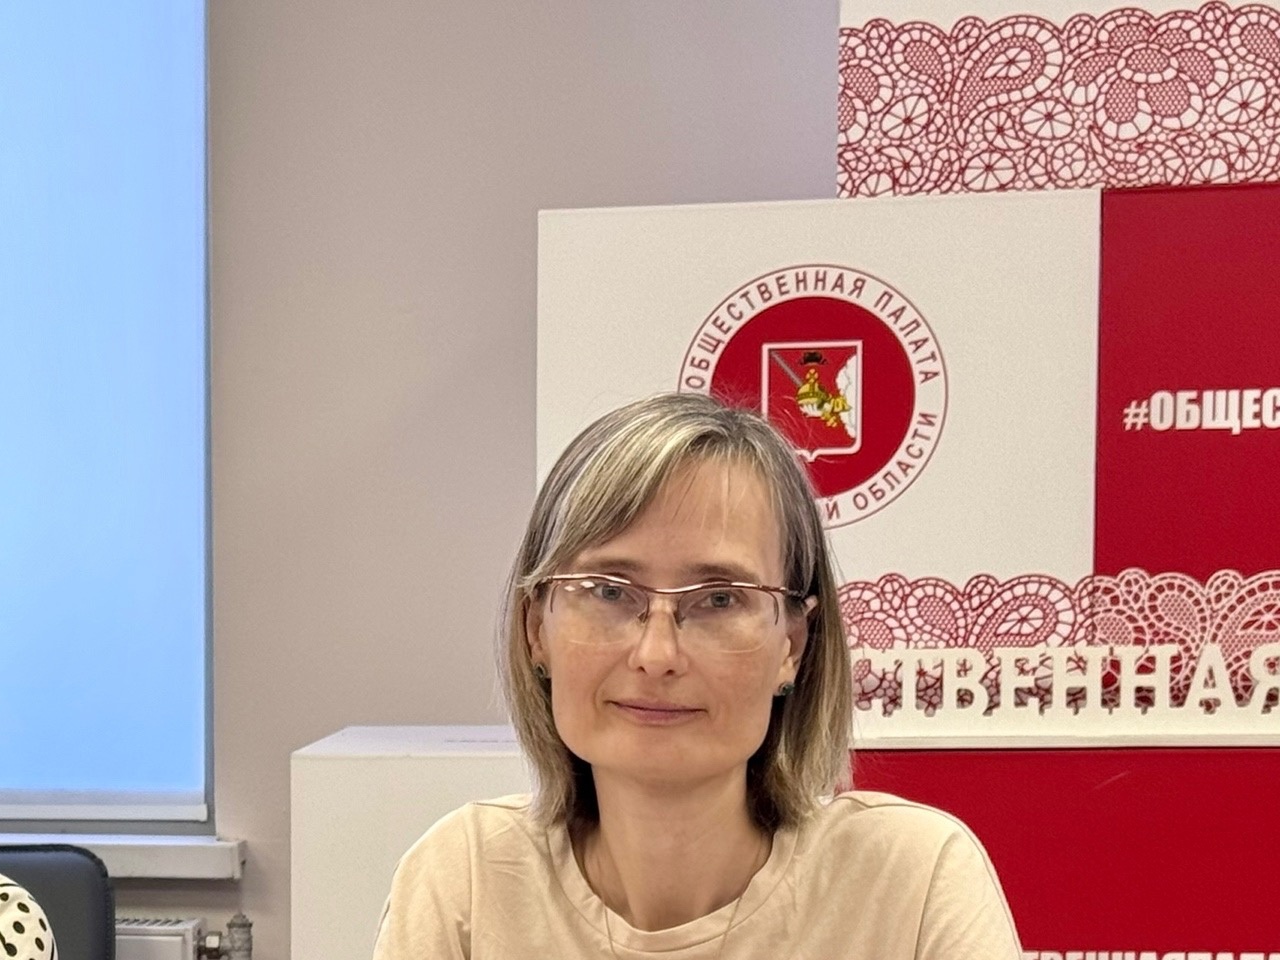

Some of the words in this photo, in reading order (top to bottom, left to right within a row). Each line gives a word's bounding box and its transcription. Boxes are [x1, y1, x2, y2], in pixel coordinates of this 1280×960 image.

[685, 270, 868, 390] ОБЩЕСТВЕННАЯ
[874, 290, 940, 385] ПАЛАТА
[852, 412, 938, 512] ОБЛАСТИ
